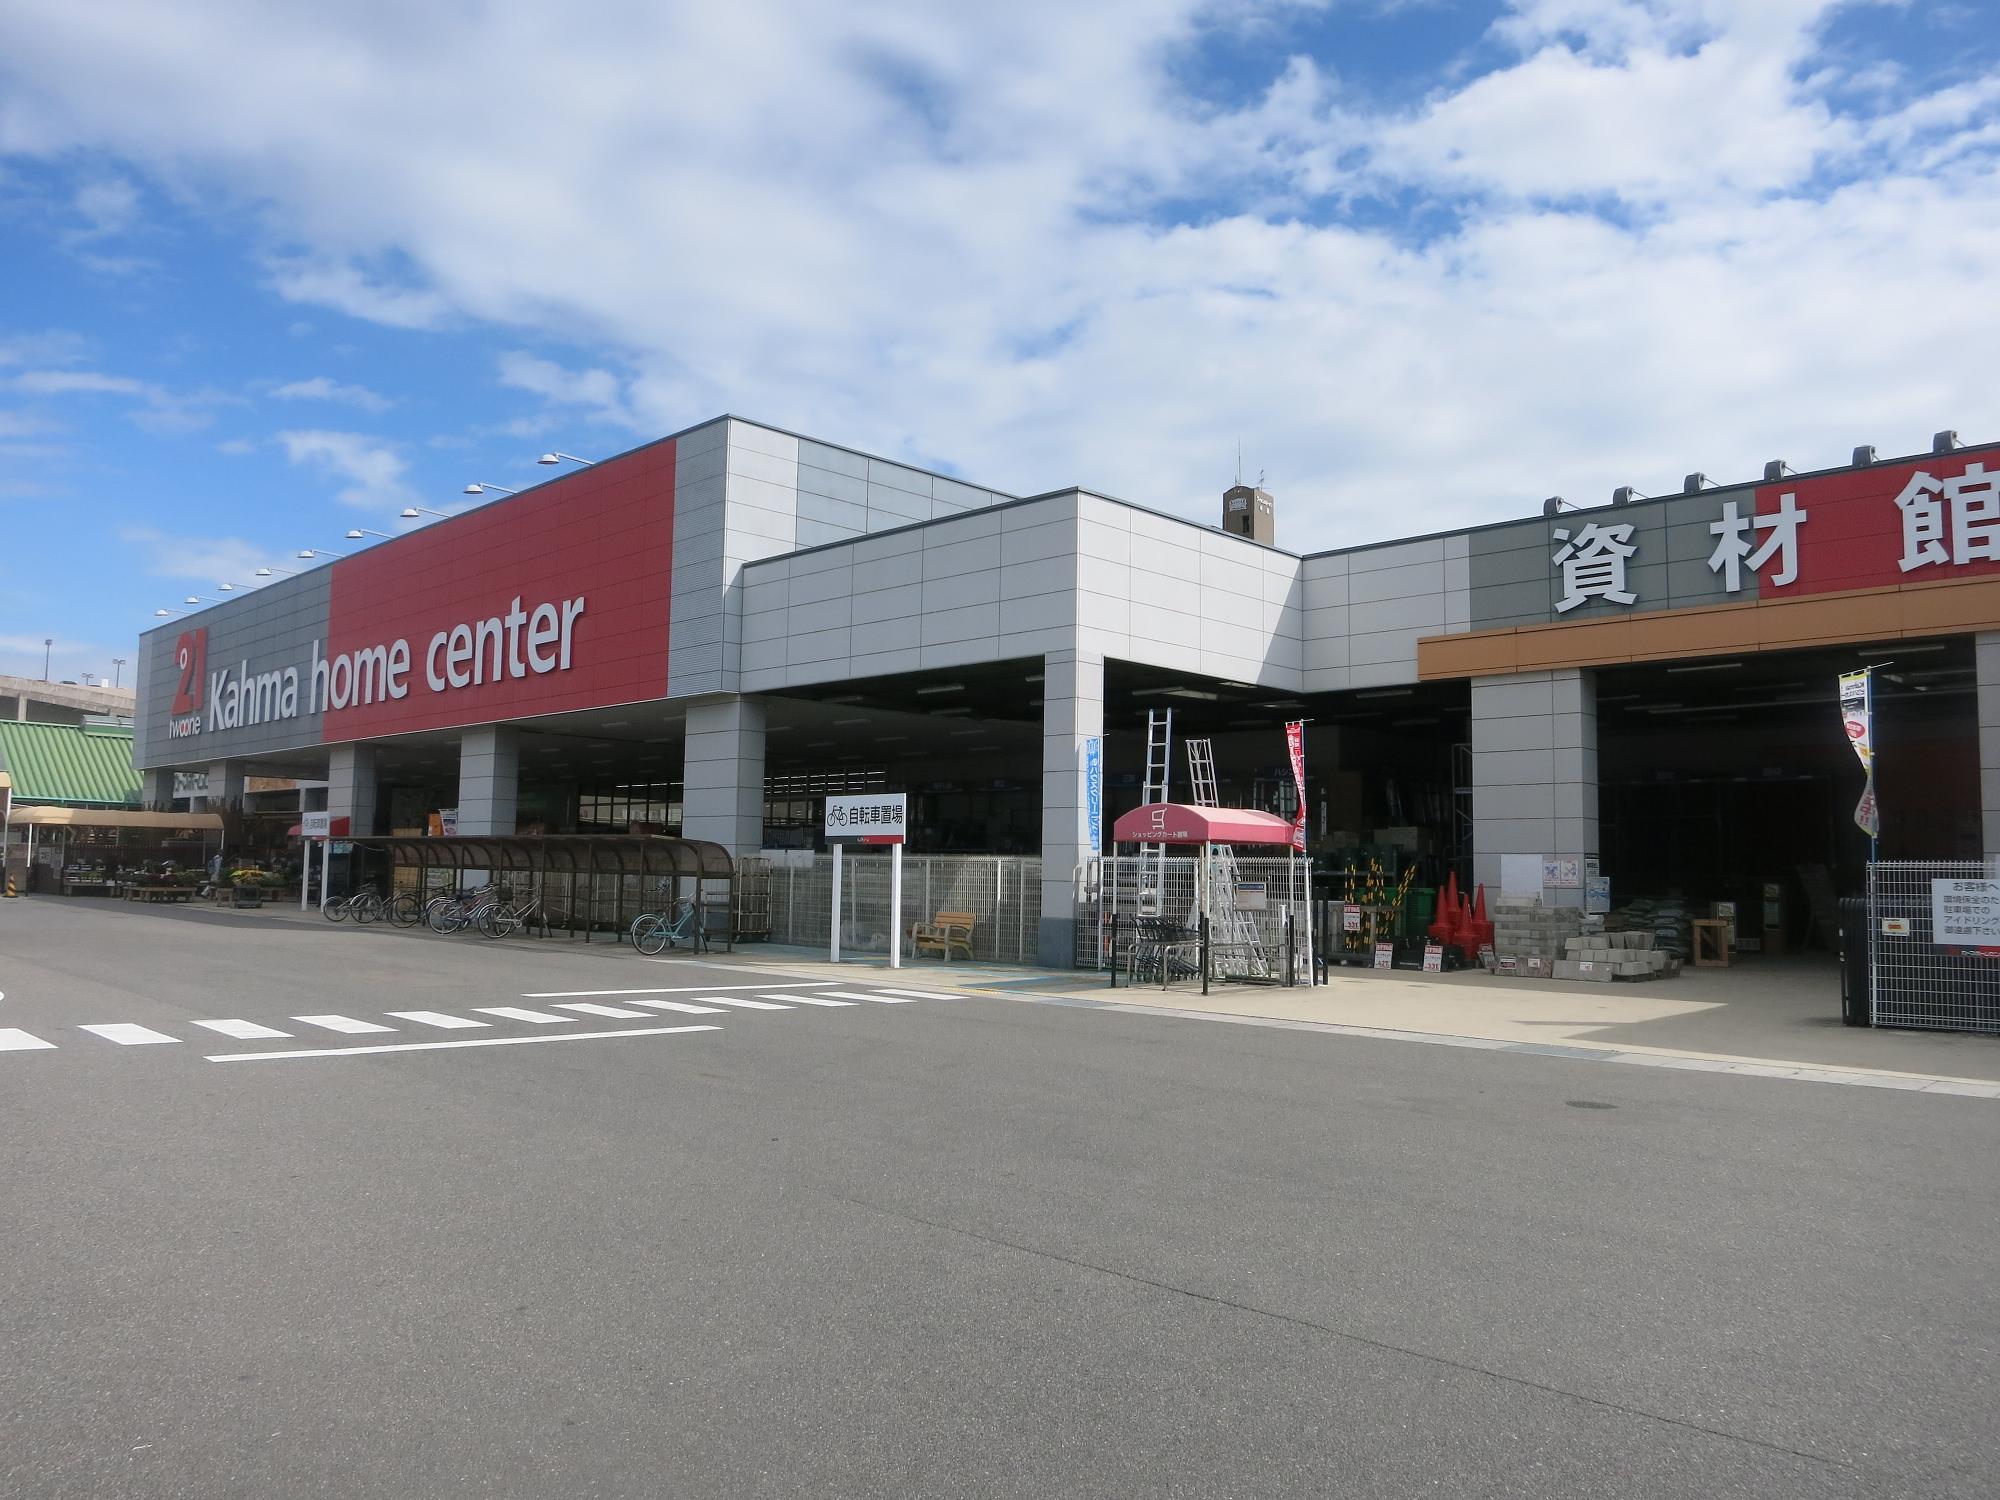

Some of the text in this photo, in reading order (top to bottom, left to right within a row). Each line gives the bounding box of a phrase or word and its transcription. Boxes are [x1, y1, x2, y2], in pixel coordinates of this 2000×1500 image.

[1552, 462, 2000, 613] 資材館
[171, 626, 208, 716] 21
[209, 595, 584, 732] Kahma home center
[849, 805, 903, 825] 自転車置場
[1943, 906, 1991, 915] 駐車場での
[1953, 882, 1999, 892] お客様へ
